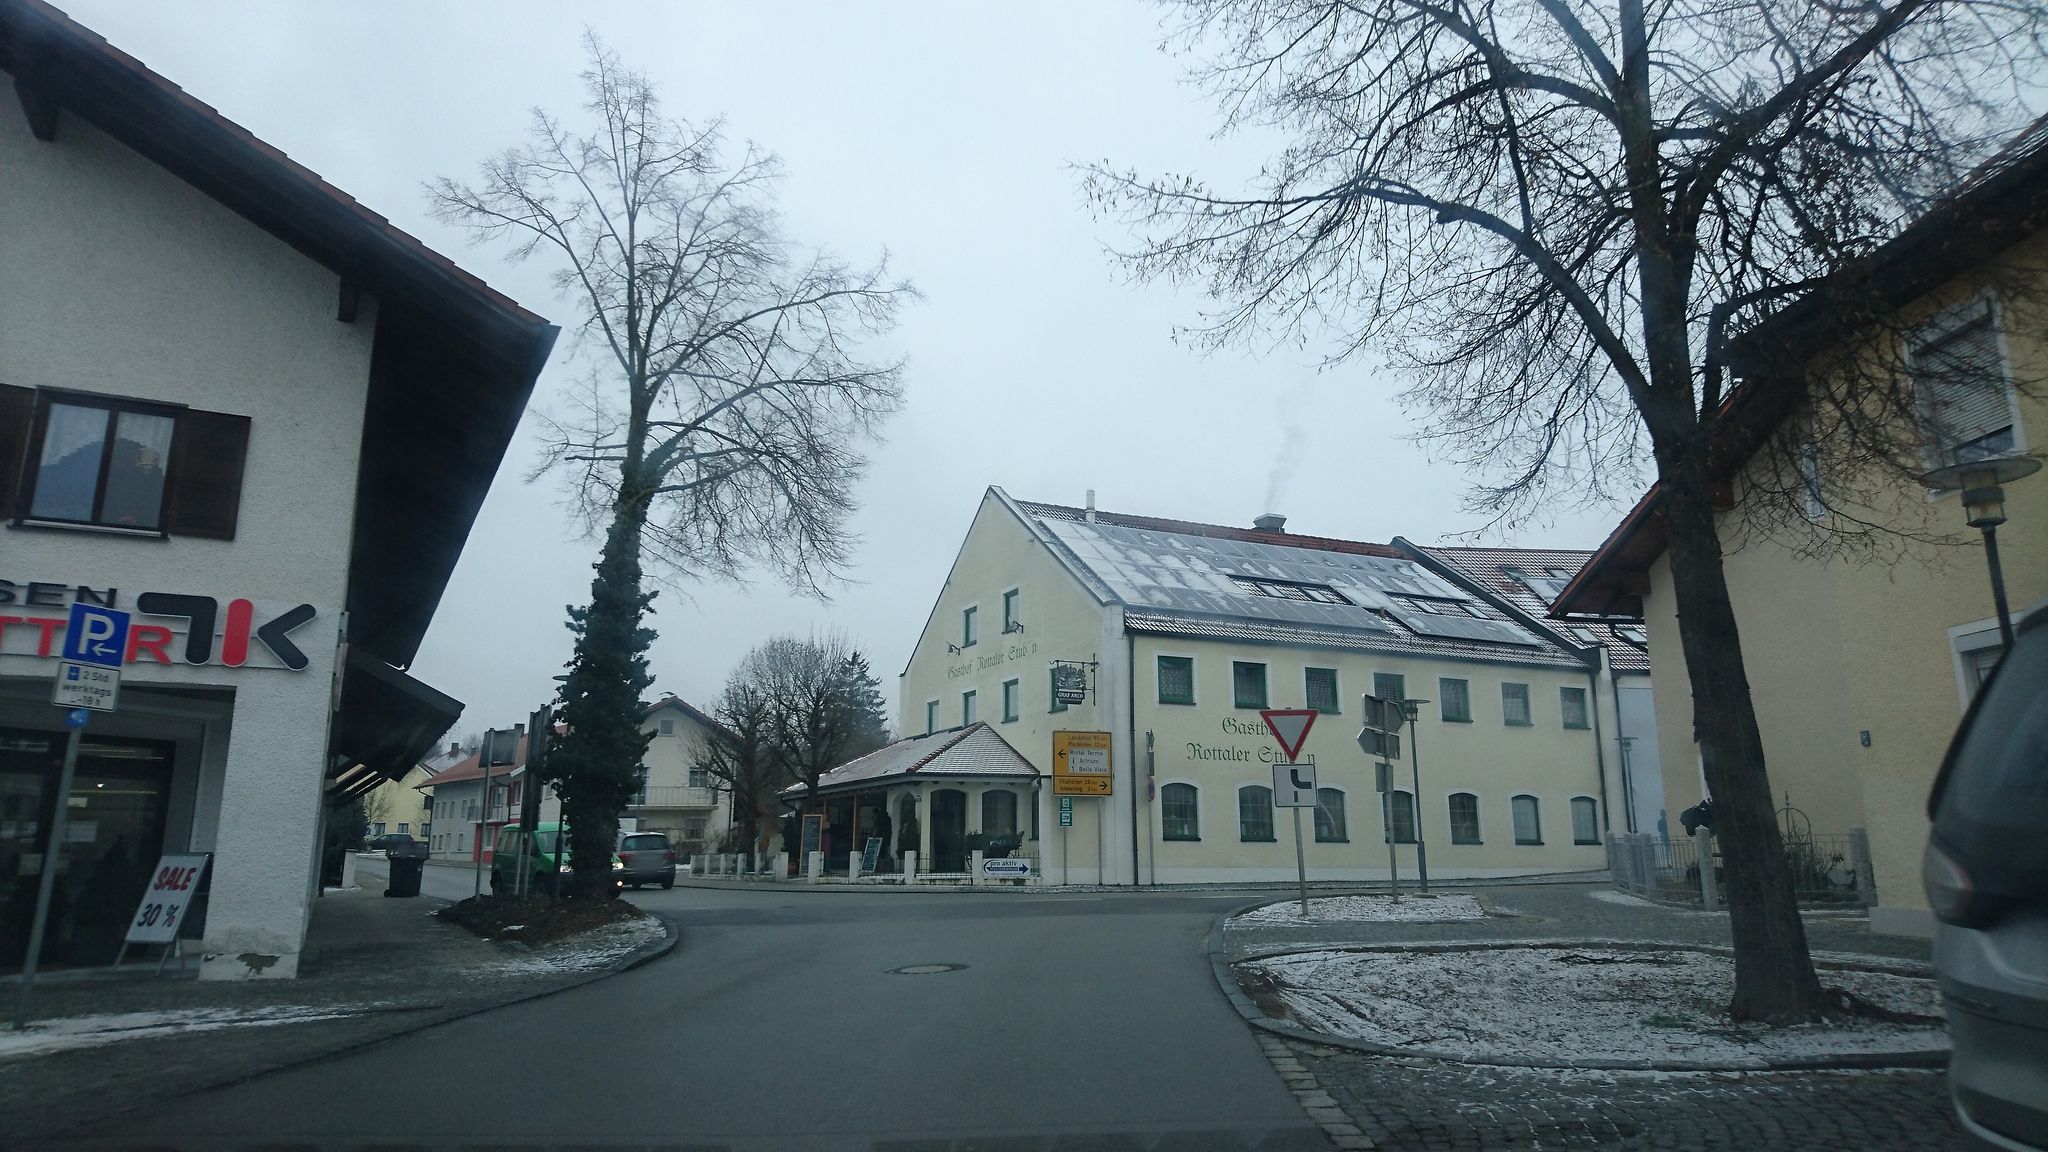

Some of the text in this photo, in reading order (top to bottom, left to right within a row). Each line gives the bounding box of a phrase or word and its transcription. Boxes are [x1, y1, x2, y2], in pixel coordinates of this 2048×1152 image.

[0, 616, 174, 665] TTR
[77, 612, 115, 655] P
[83, 670, 90, 680] 2
[947, 658, 973, 681] Gasthof
[977, 652, 1005, 671] Rottaler
[62, 683, 112, 698] werktags
[1222, 717, 1274, 740] Gasth
[1186, 742, 1250, 762] Rottaler
[153, 866, 198, 892] SALE
[137, 903, 180, 928] 30 %
